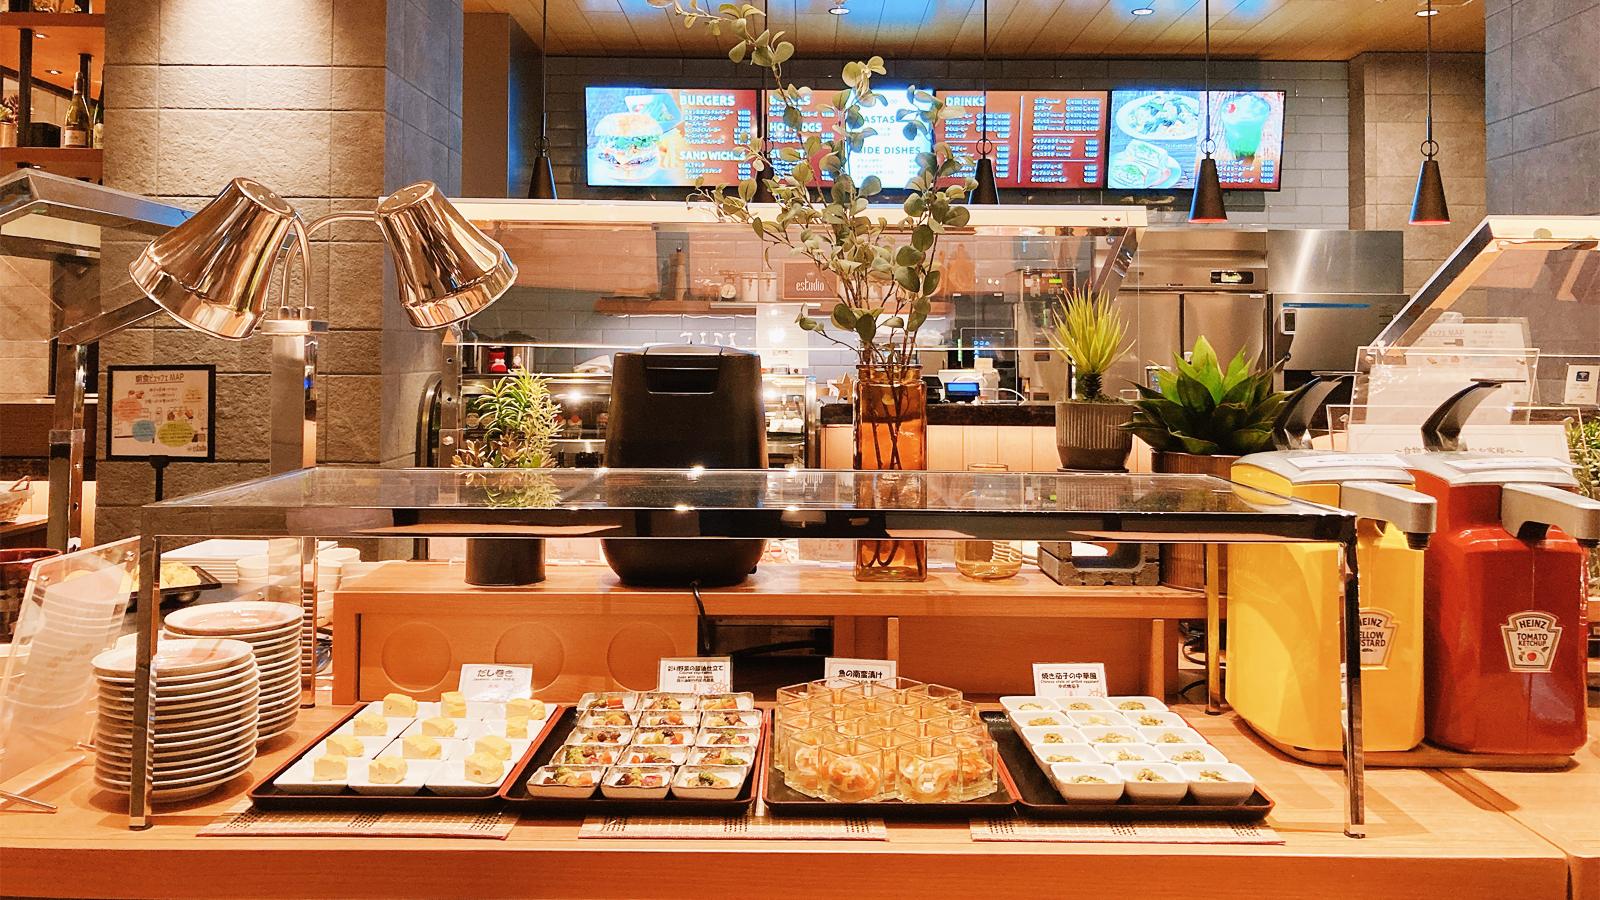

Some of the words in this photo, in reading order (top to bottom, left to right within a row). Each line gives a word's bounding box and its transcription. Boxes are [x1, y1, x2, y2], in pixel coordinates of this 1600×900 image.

[680, 95, 735, 106] BURGERS
[946, 96, 985, 107] DRINKS
[864, 115, 895, 124] ASTAS
[802, 123, 822, 132] OGS
[884, 146, 920, 154] DISHES
[680, 151, 746, 160] SANDWICHS
[796, 277, 825, 292] estudio
[169, 373, 184, 381] MAP
[1519, 619, 1548, 630] HEINZ
[1360, 631, 1384, 639] ELLOW
[1517, 632, 1548, 641] TOMATO
[1360, 639, 1386, 647] STARD
[477, 669, 513, 678] だし巻き
[1041, 672, 1097, 680] 焼き茄子の中華風
